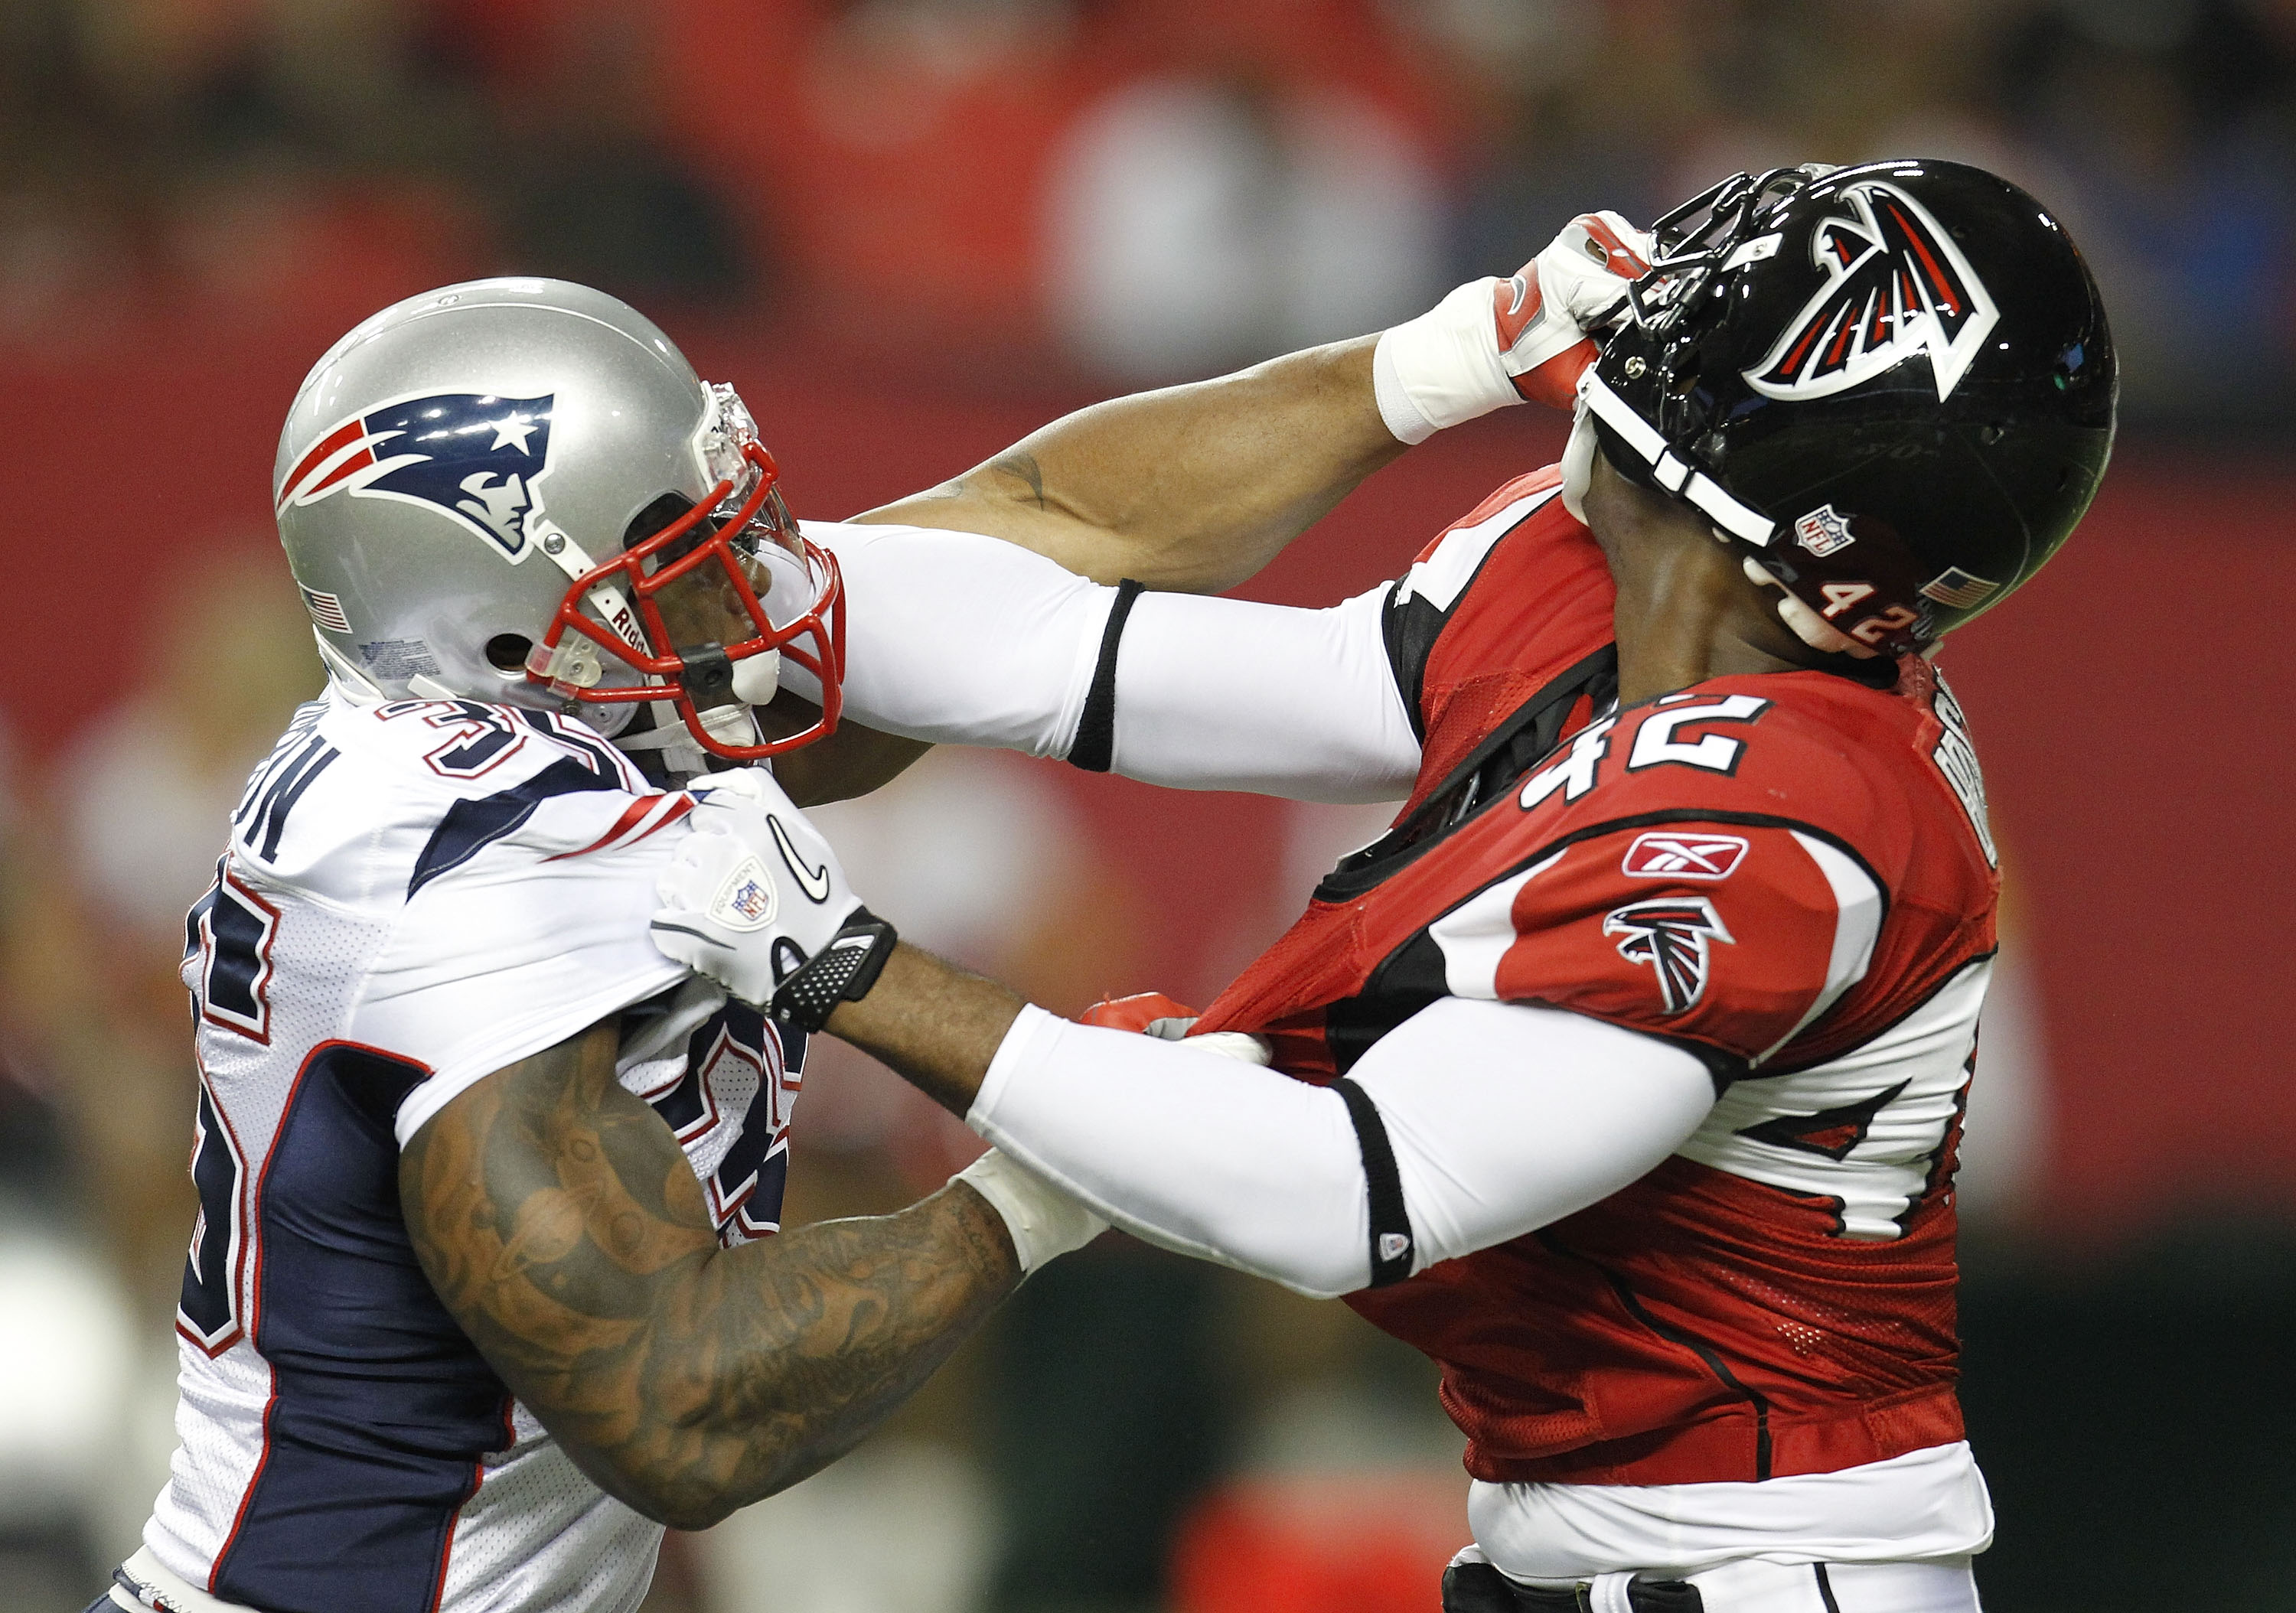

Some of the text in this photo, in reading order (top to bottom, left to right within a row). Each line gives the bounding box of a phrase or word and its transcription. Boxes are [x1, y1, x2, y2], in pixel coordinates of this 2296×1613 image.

[1802, 520, 1831, 552] NFL
[1820, 582, 1917, 644] 42
[1519, 693, 1771, 810] 42
